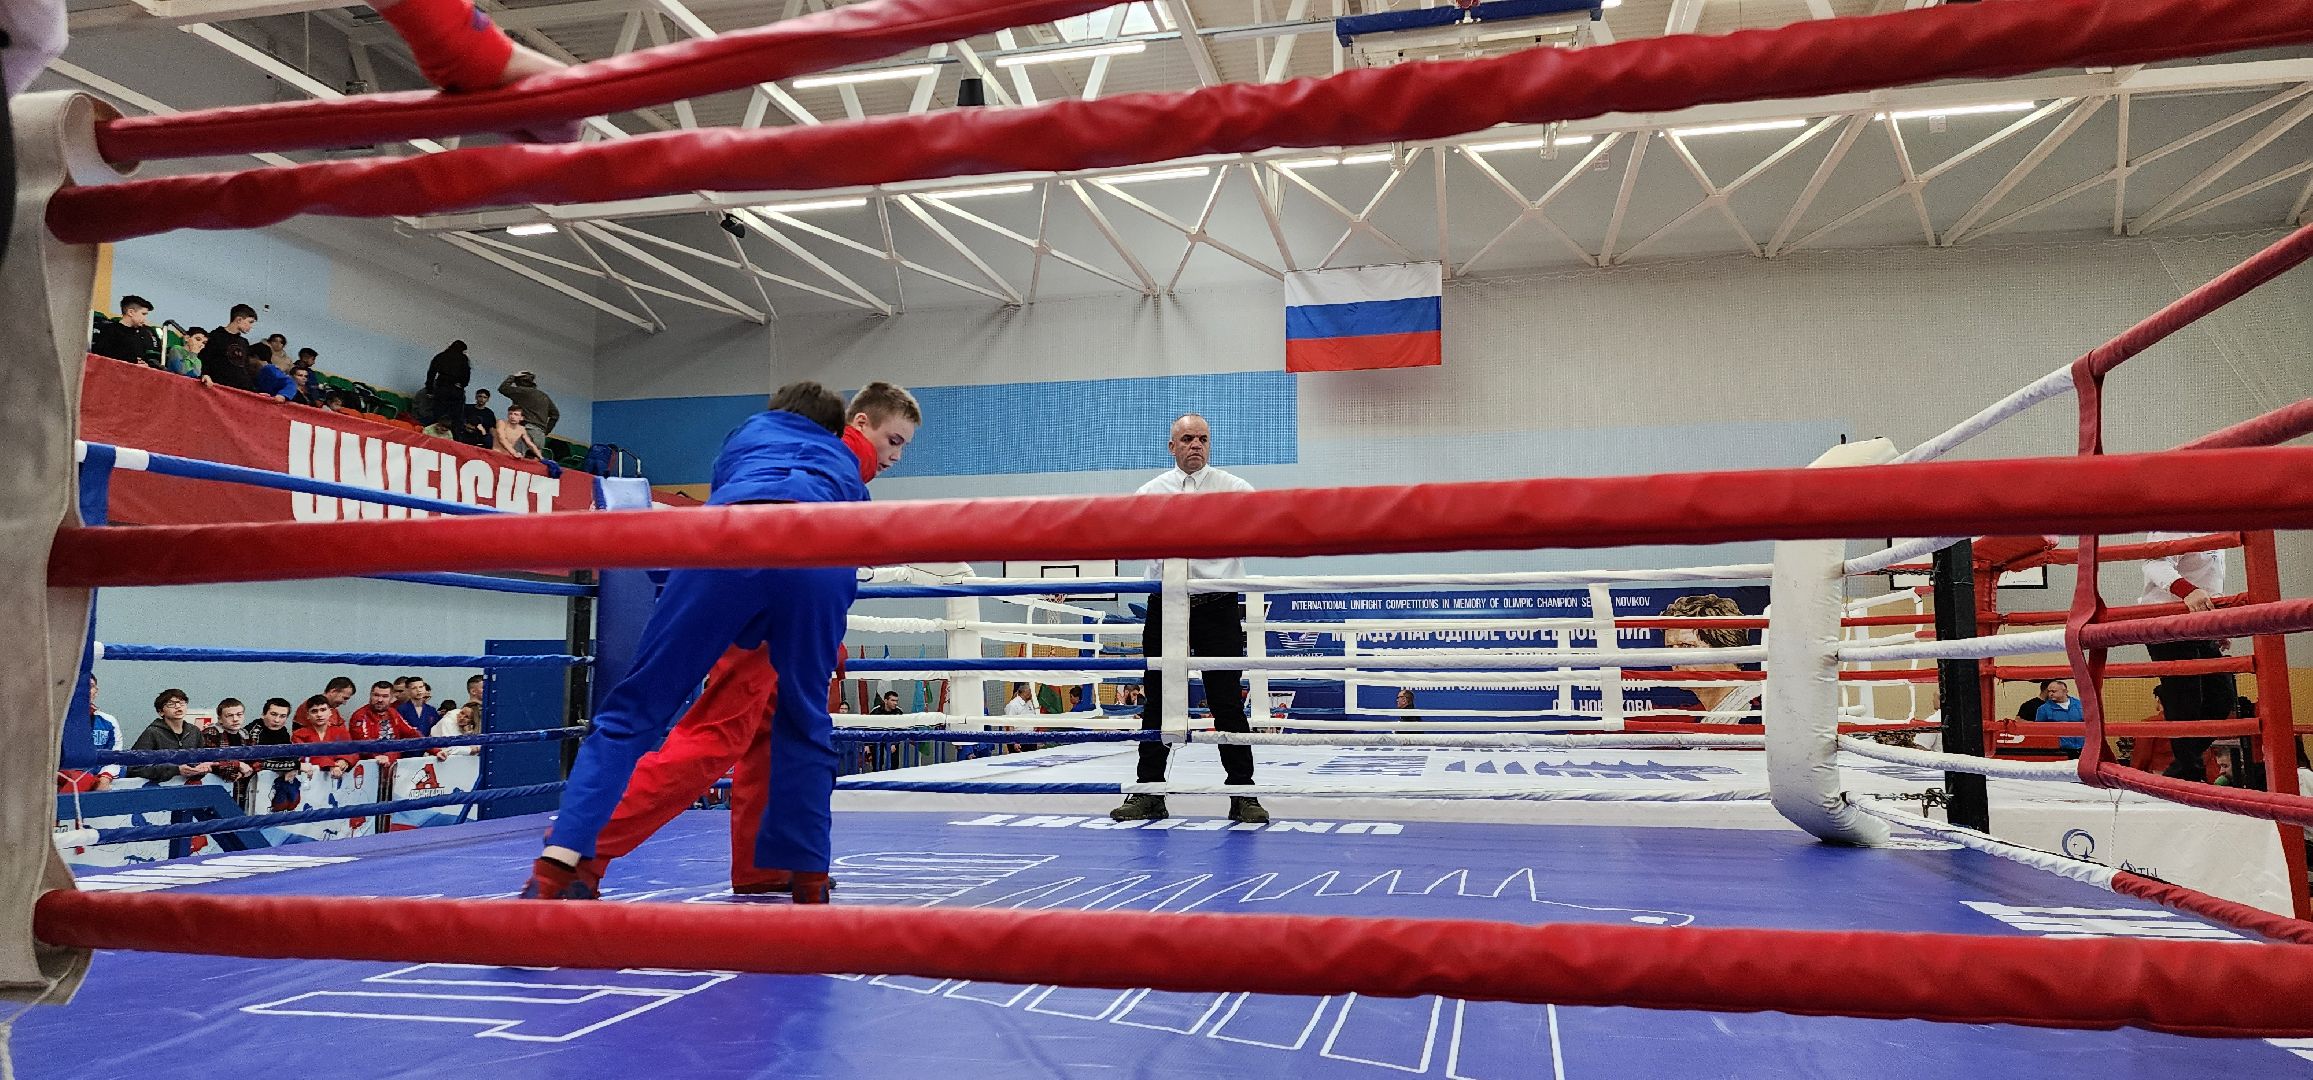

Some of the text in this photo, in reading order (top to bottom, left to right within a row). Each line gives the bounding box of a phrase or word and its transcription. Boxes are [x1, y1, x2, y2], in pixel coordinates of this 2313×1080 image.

[289, 420, 560, 523] UNIFIGHT
[1291, 600, 1347, 610] INTERNATIONAL
[1350, 599, 1382, 610] UNIFIGHT
[1386, 599, 1439, 609] COMPETITIONS
[1442, 599, 1449, 609] IN
[1453, 598, 1486, 609] MEMORY
[1489, 598, 1499, 608] OF
[1537, 597, 1577, 608] CHAMPION
[1615, 596, 1650, 607] NOVIKOV
[947, 814, 1405, 835] UNIFIGHT
